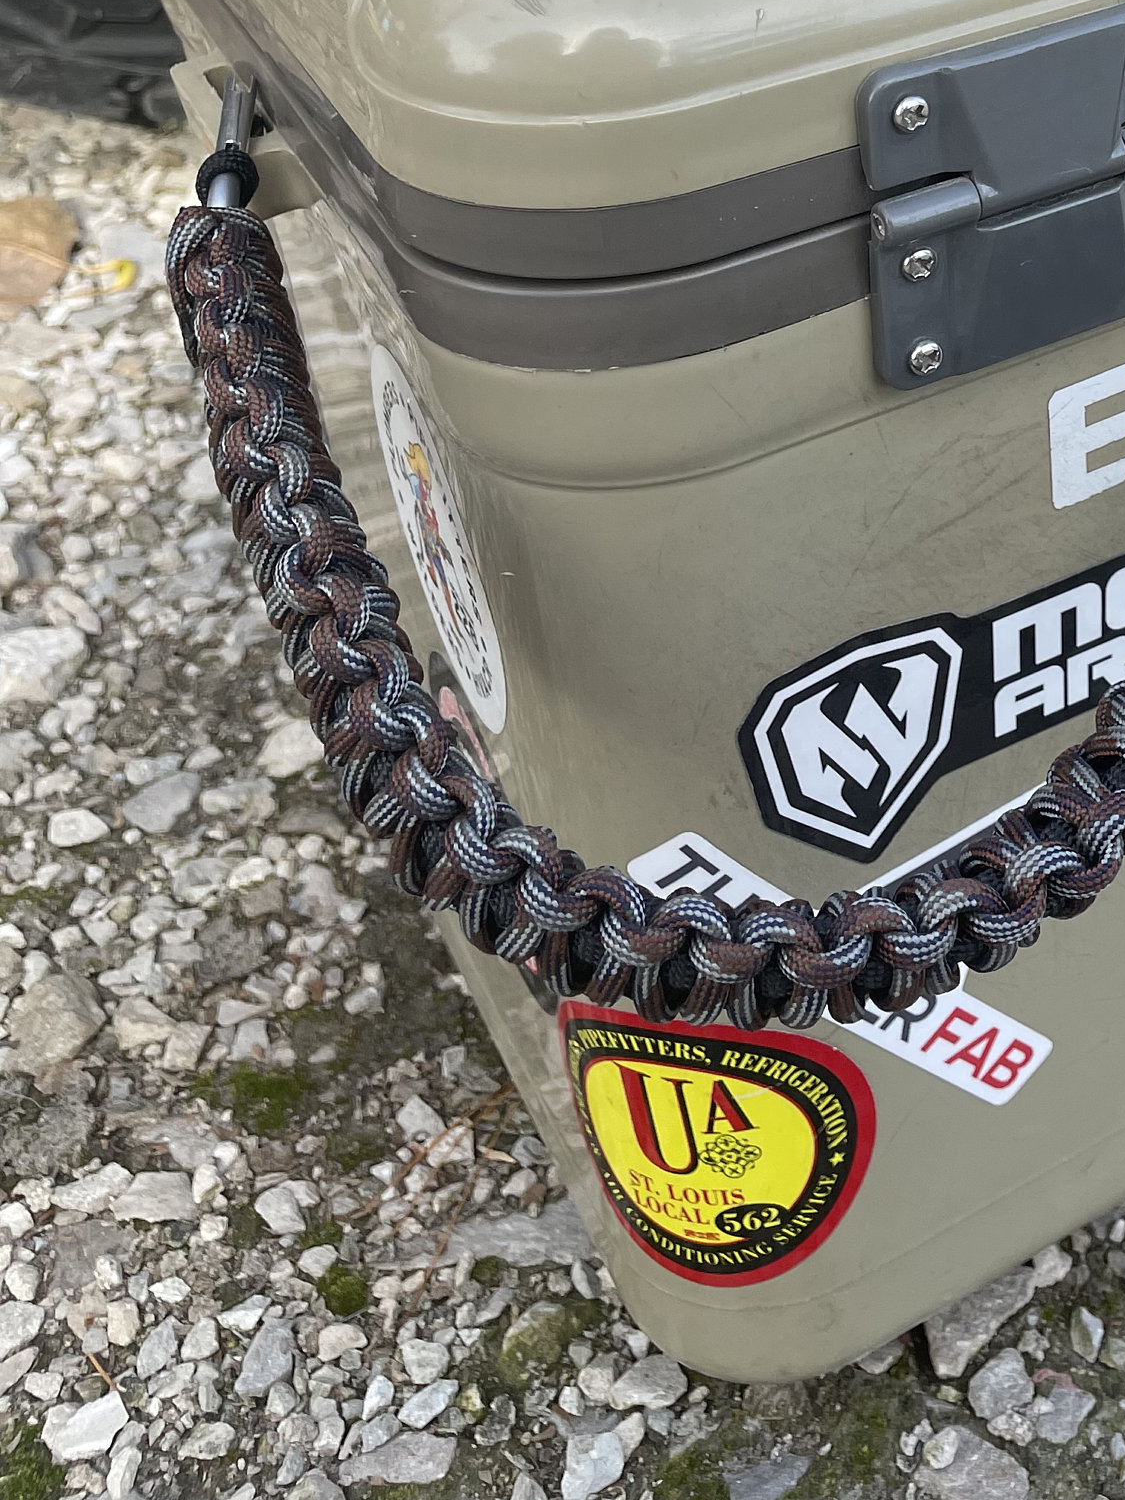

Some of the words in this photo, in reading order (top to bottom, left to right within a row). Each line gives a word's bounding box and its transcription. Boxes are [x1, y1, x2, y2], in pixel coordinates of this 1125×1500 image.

[920, 1006, 1035, 1090] FAB
[611, 1060, 760, 1175] UA
[720, 1049, 848, 1149] REFRIGERATION
[625, 1206, 774, 1265] CONDITIONING
[773, 1173, 838, 1246] SERVICE
[629, 1169, 660, 1196] ST.
[667, 1184, 746, 1206] LOUIS
[634, 1189, 711, 1225] LOCAL
[722, 1206, 782, 1233] 562
